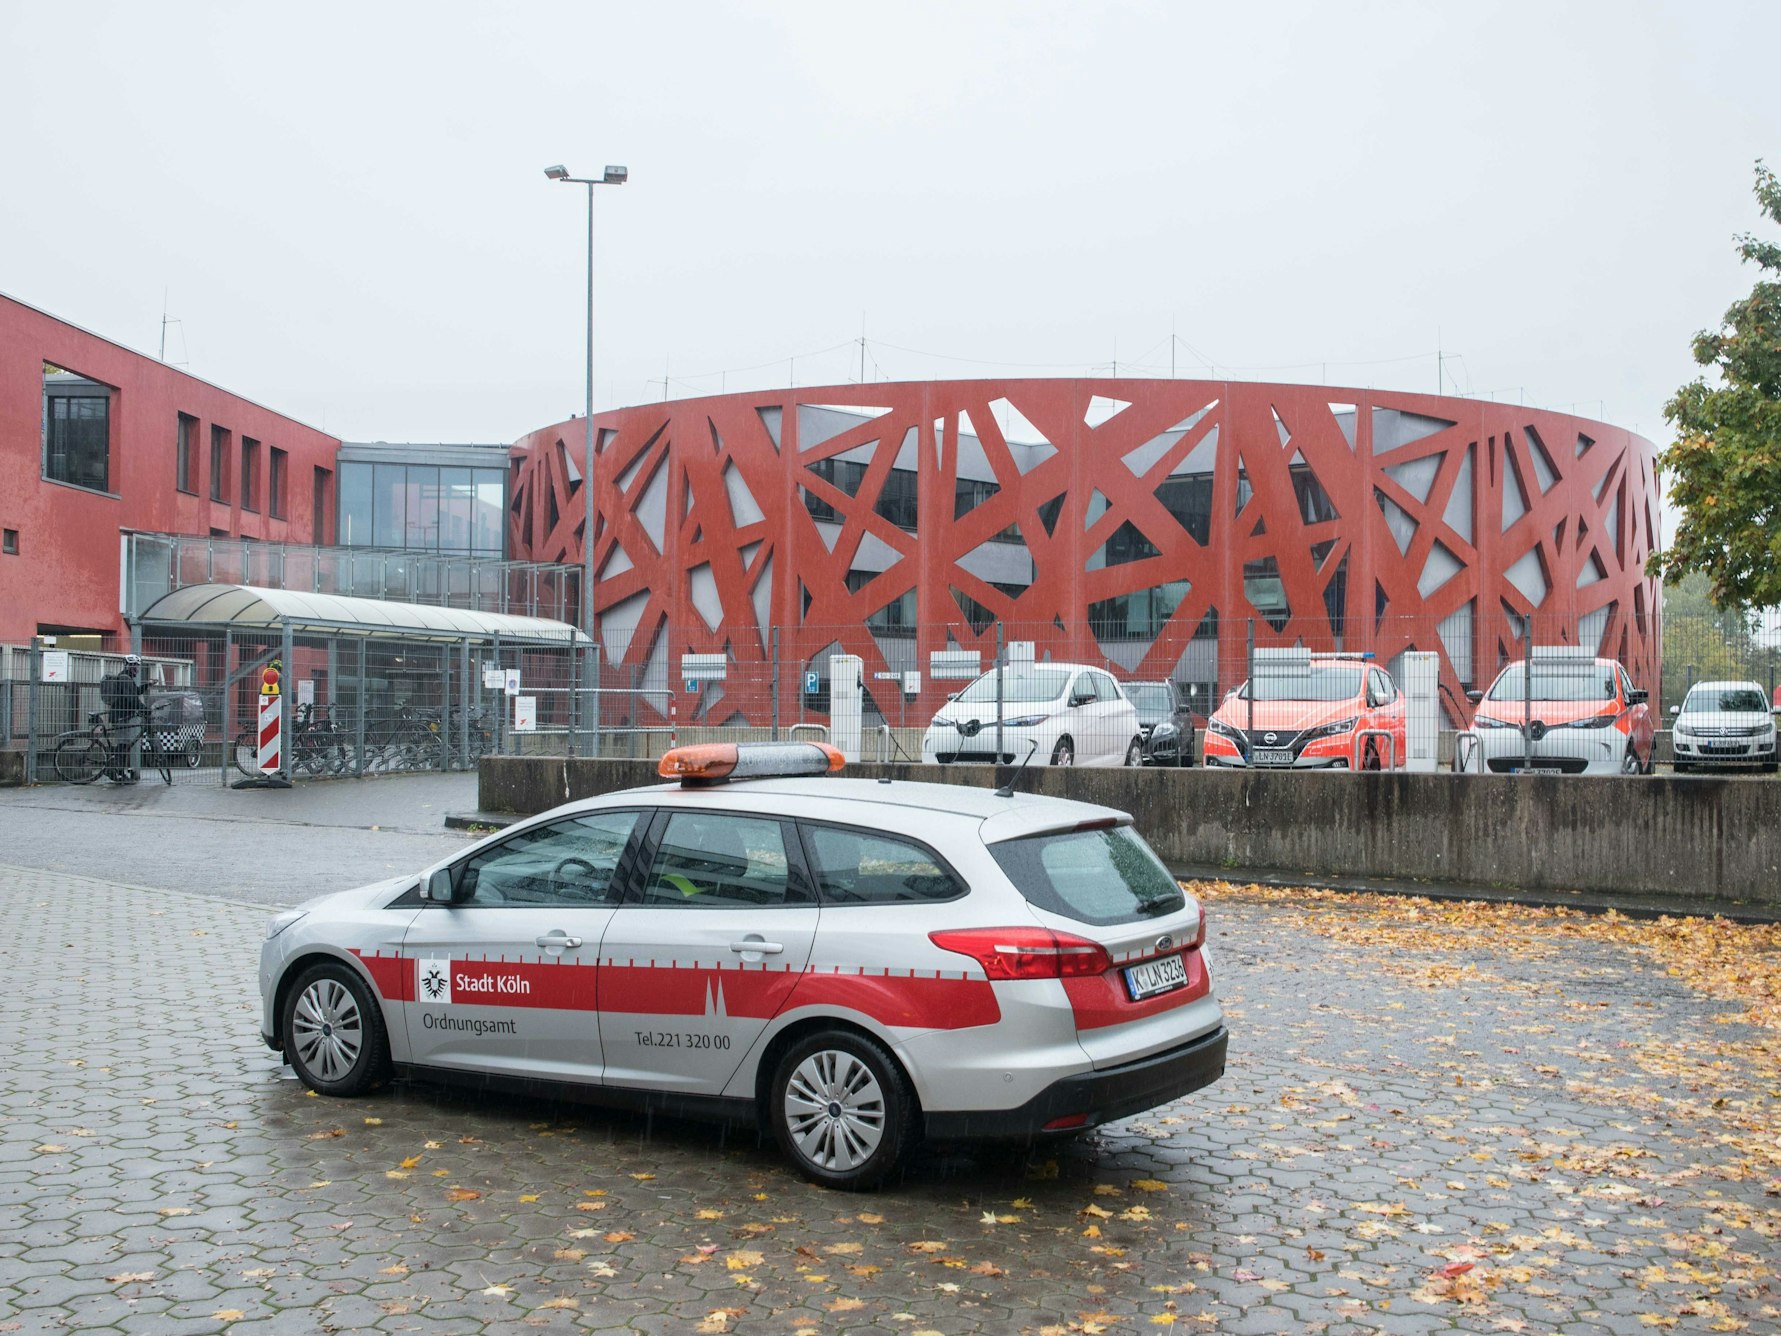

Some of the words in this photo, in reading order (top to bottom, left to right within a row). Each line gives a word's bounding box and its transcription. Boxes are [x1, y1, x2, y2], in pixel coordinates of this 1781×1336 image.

[807, 673, 816, 687] P
[456, 973, 494, 992] Stadt
[497, 975, 530, 994] Köln
[1132, 969, 1143, 991] K
[423, 1013, 517, 1036] Ordnungsamt
[685, 1033, 711, 1049] 320
[714, 1034, 731, 1050] 00
